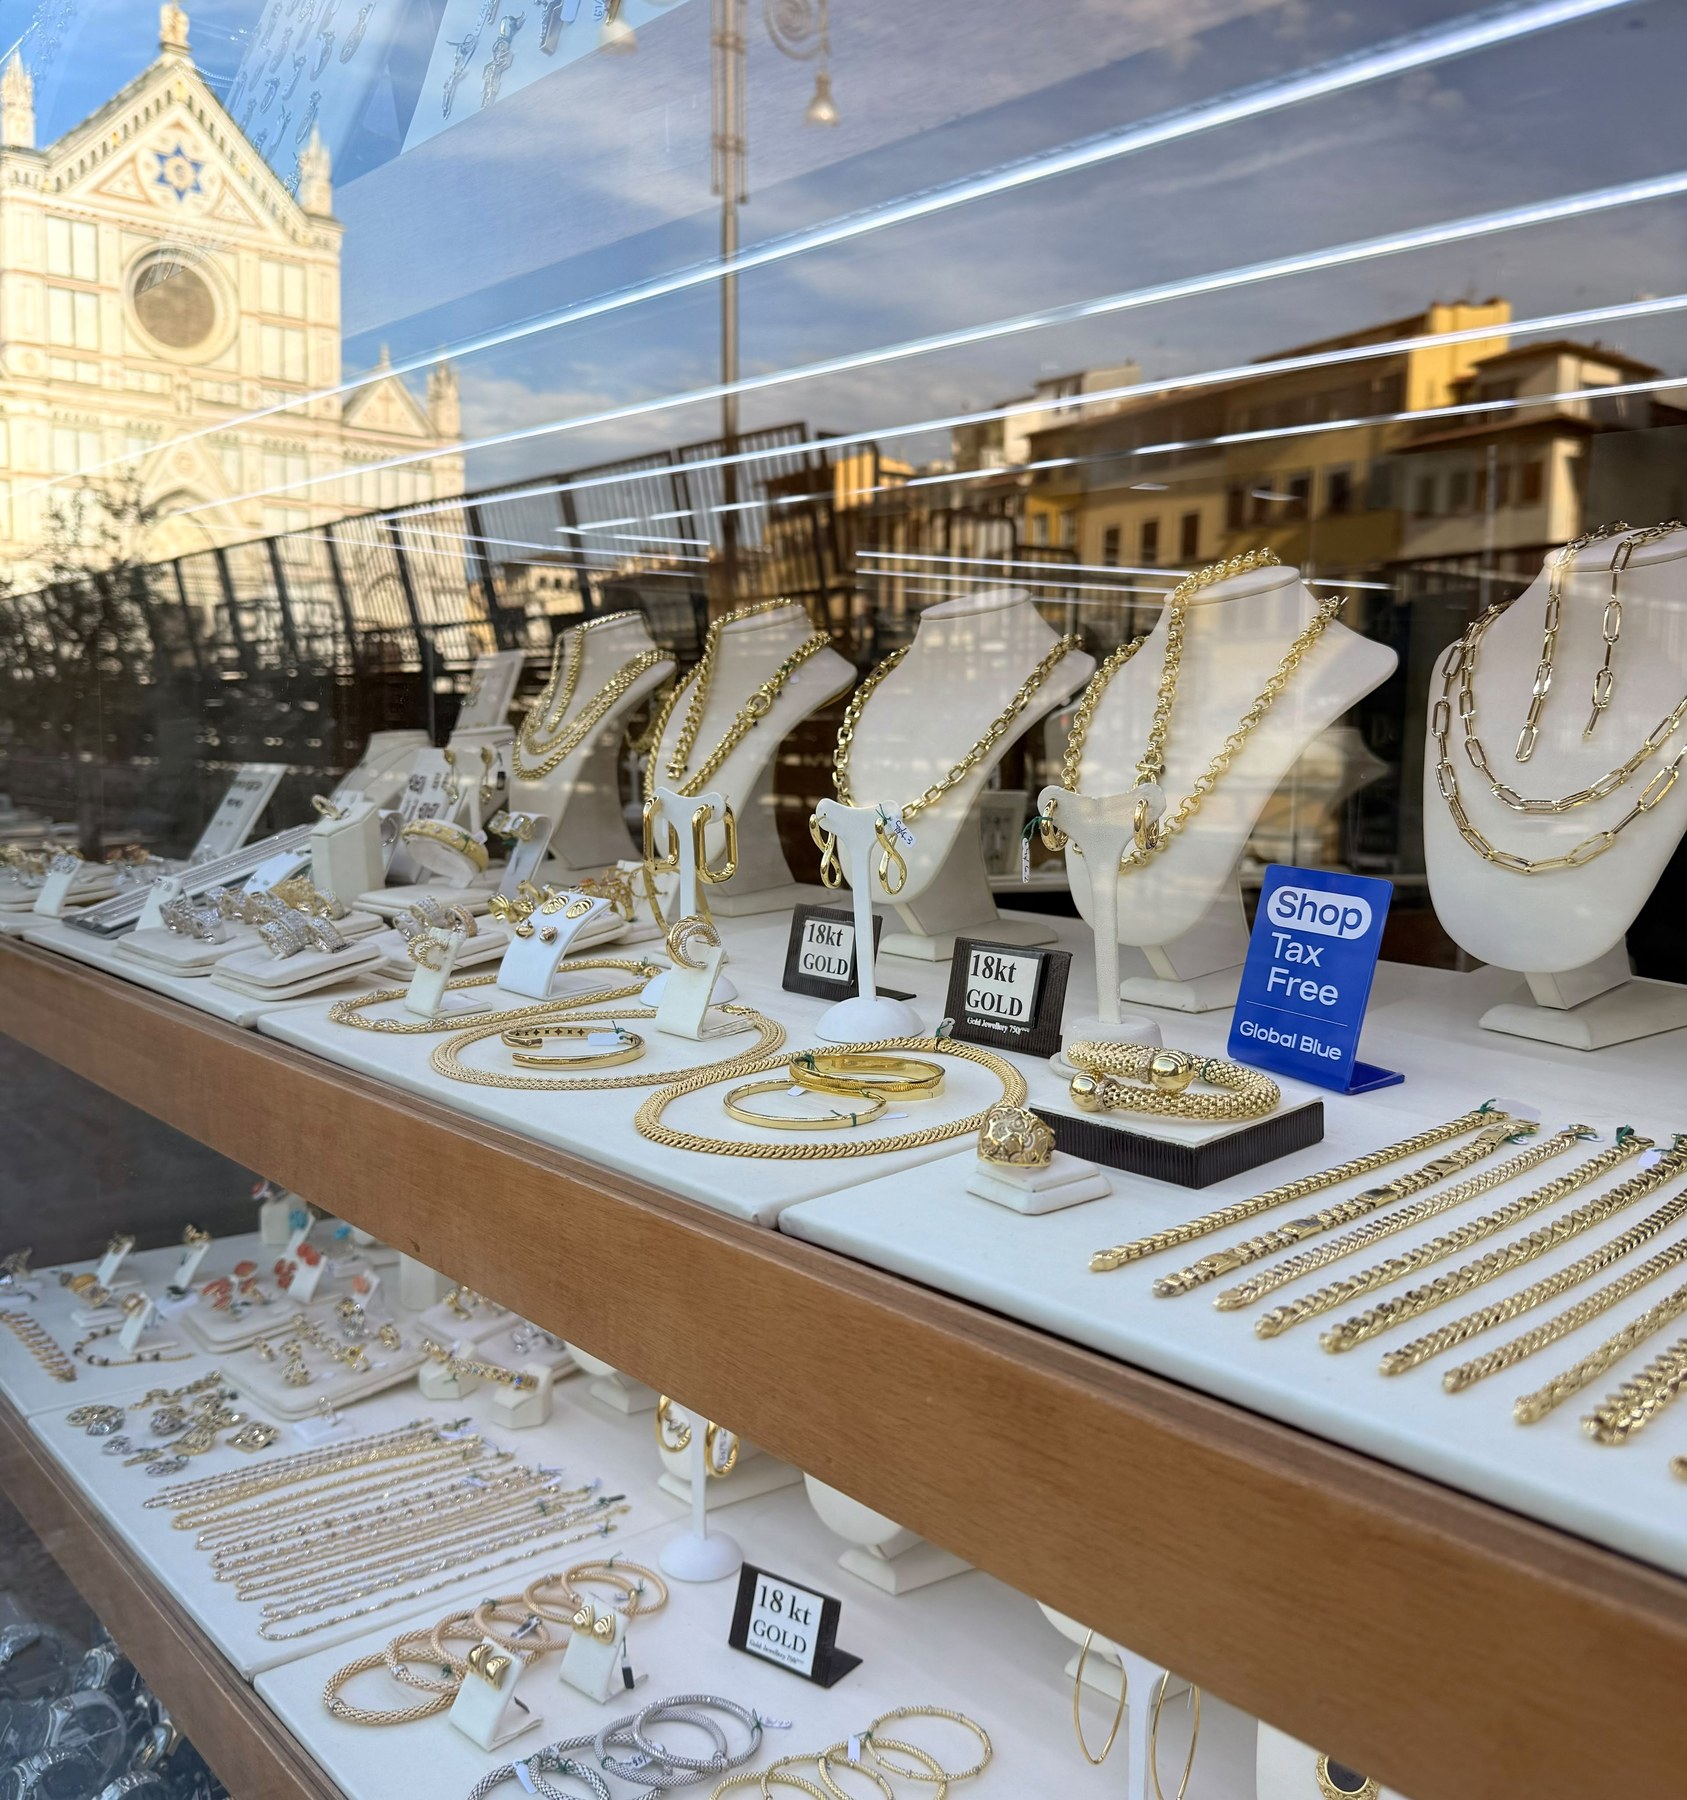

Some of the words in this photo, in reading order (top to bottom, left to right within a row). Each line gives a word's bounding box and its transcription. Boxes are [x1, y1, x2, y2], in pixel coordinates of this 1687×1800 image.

[1276, 890, 1362, 935] Shop
[807, 923, 843, 947] 18kt
[1271, 932, 1324, 967] Tax
[803, 953, 848, 976] GOLD
[970, 954, 1017, 983] 18kt
[966, 988, 1023, 1016] GOLD
[1266, 967, 1338, 1006] Free
[967, 1017, 981, 1026] Gold
[1239, 1020, 1297, 1049] Global
[1300, 1036, 1341, 1060] Blue
[753, 1620, 806, 1654] GOLD
